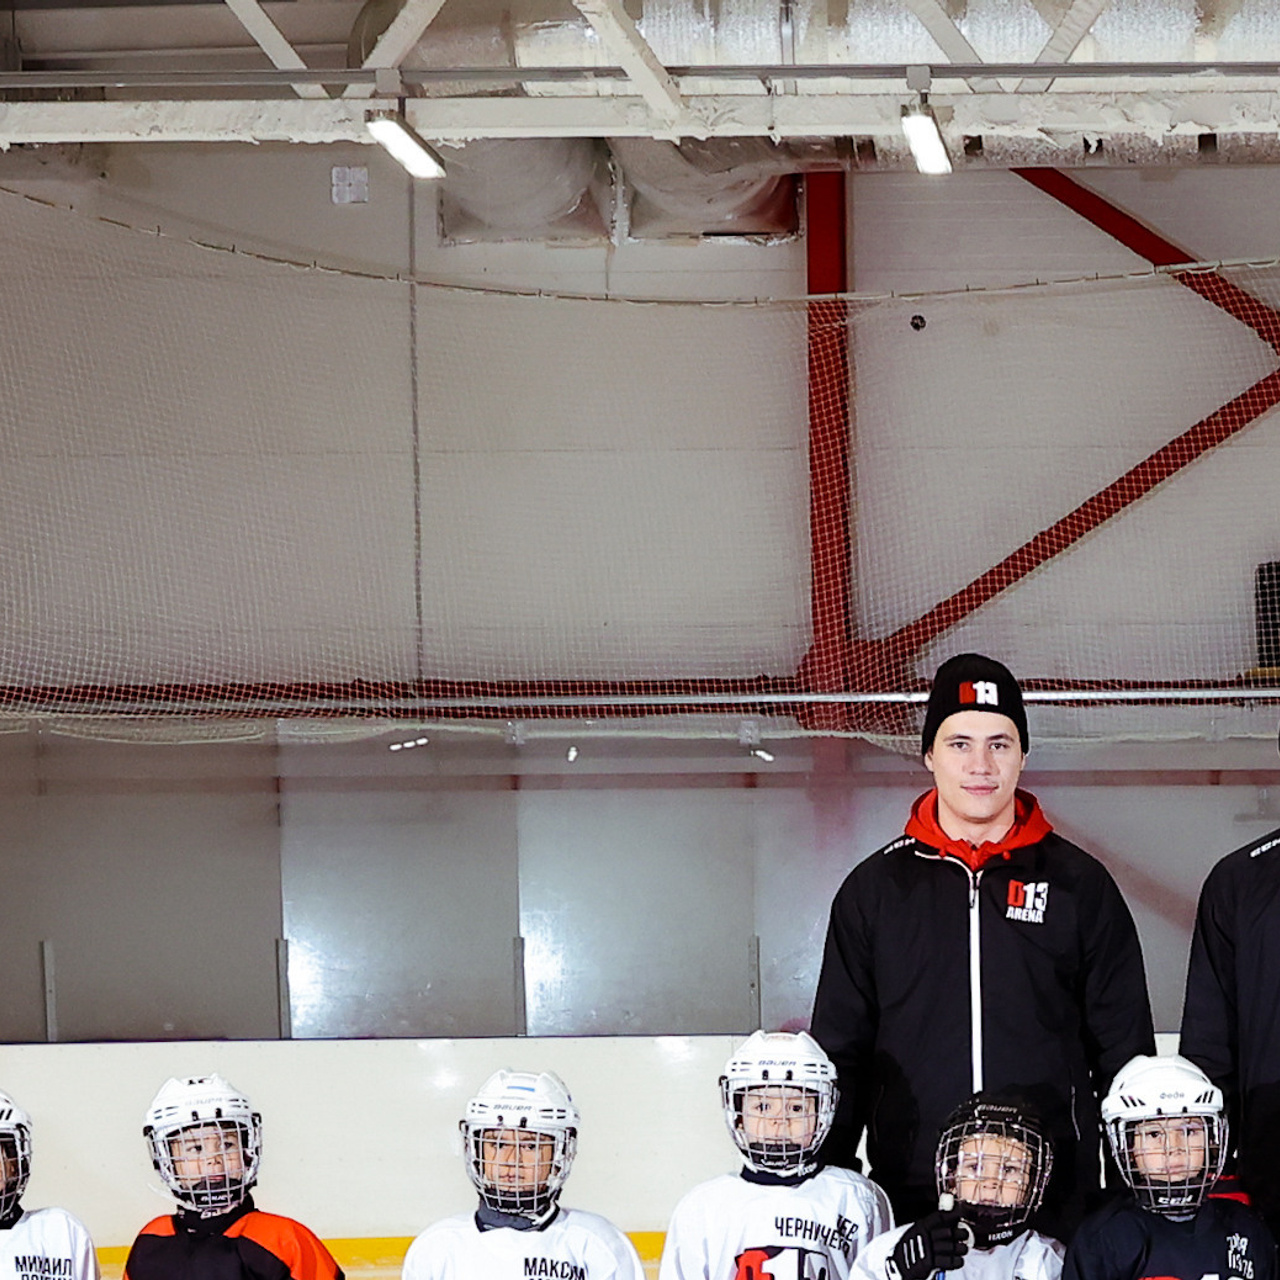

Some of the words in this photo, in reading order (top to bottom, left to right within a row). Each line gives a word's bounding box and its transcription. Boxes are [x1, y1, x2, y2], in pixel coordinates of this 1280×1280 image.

[958, 681, 999, 706] D13
[1007, 879, 1049, 912] D13
[1005, 906, 1045, 924] ARENA
